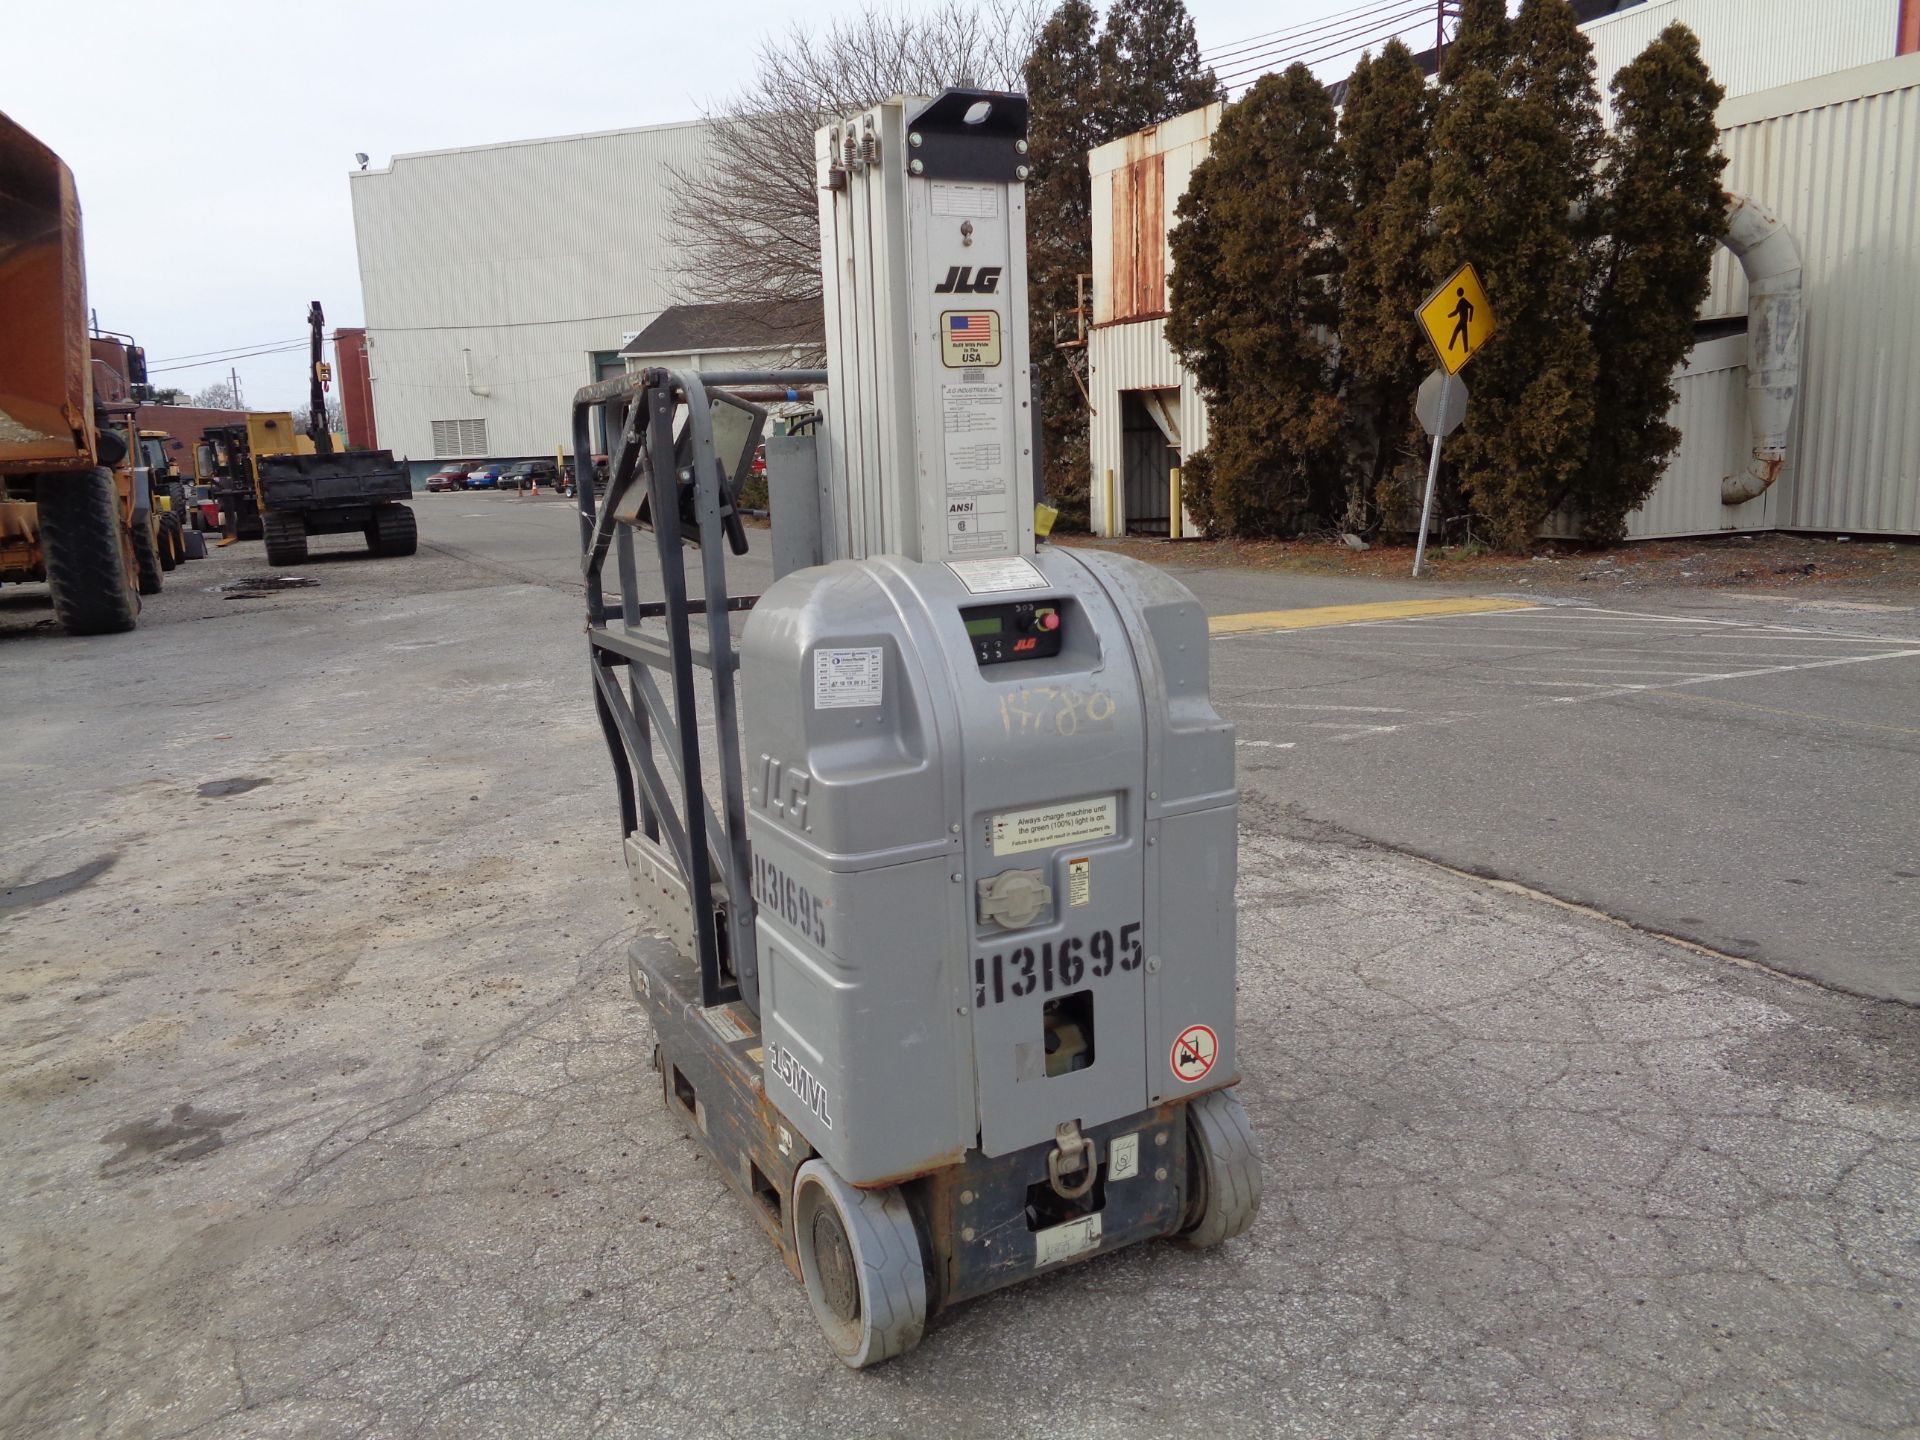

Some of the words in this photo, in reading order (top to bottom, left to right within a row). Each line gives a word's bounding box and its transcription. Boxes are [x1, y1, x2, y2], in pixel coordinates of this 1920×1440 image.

[934, 266, 1002, 294] JLG
[962, 353, 981, 362] USA
[949, 502, 974, 513] ANSI
[1017, 817, 1041, 826] Always
[1042, 813, 1064, 822] charge
[1066, 808, 1092, 818] machine
[1093, 804, 1107, 813] until
[1018, 826, 1029, 835] the
[1030, 825, 1050, 833] green
[1051, 819, 1074, 831] (100%)
[1075, 816, 1088, 826] light
[754, 853, 826, 949] 1131695
[975, 921, 1143, 1009] 1131695
[768, 1041, 833, 1131] 15MVL
